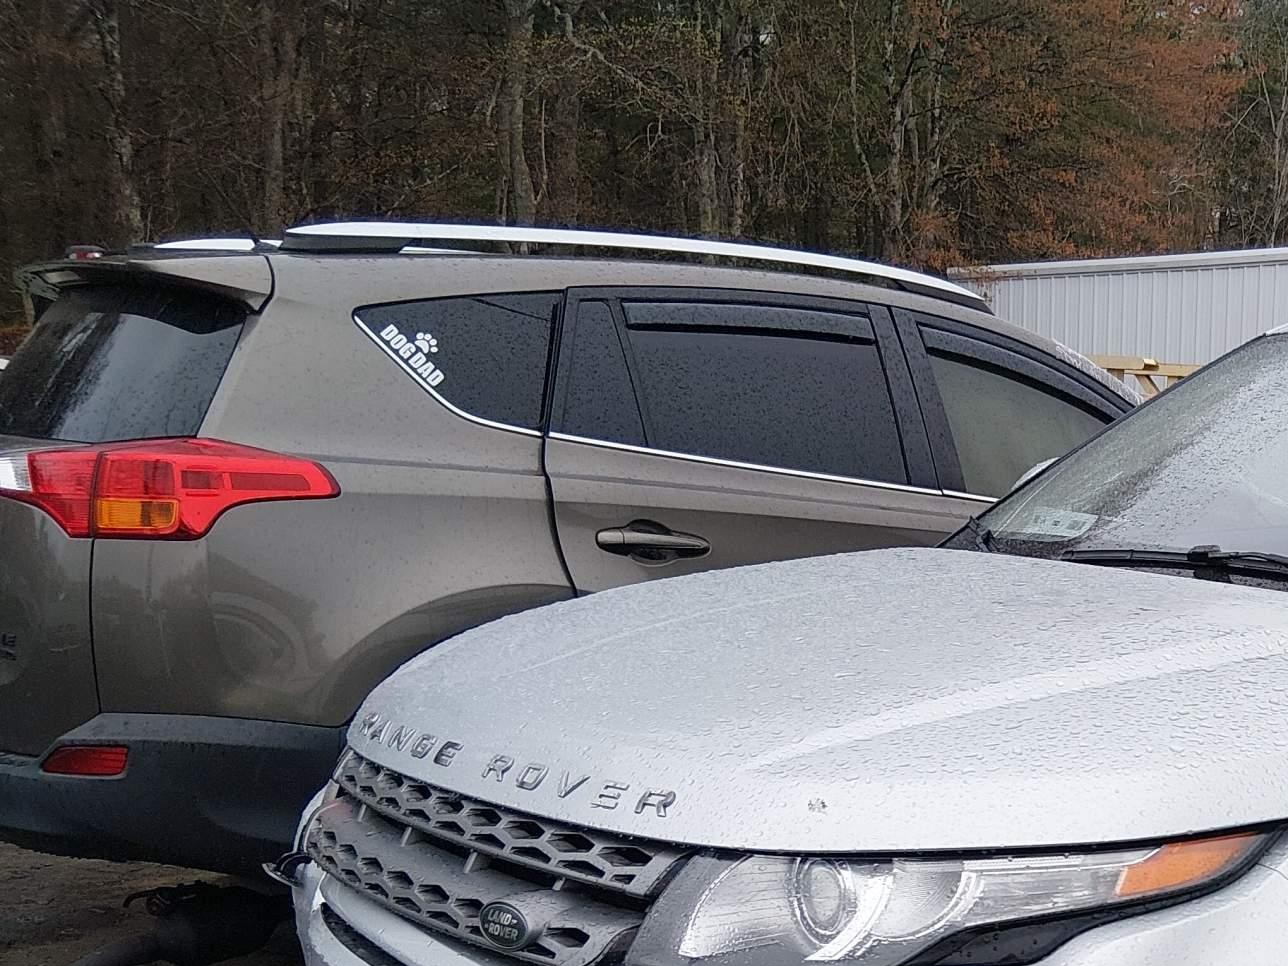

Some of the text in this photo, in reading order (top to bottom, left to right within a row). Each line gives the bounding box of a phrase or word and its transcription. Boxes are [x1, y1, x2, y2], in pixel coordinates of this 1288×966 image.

[380, 323, 445, 387] DOG DAD
[358, 711, 677, 818] RANGE ROVER
[488, 908, 513, 926] LAND
[488, 922, 519, 941] ROVER
